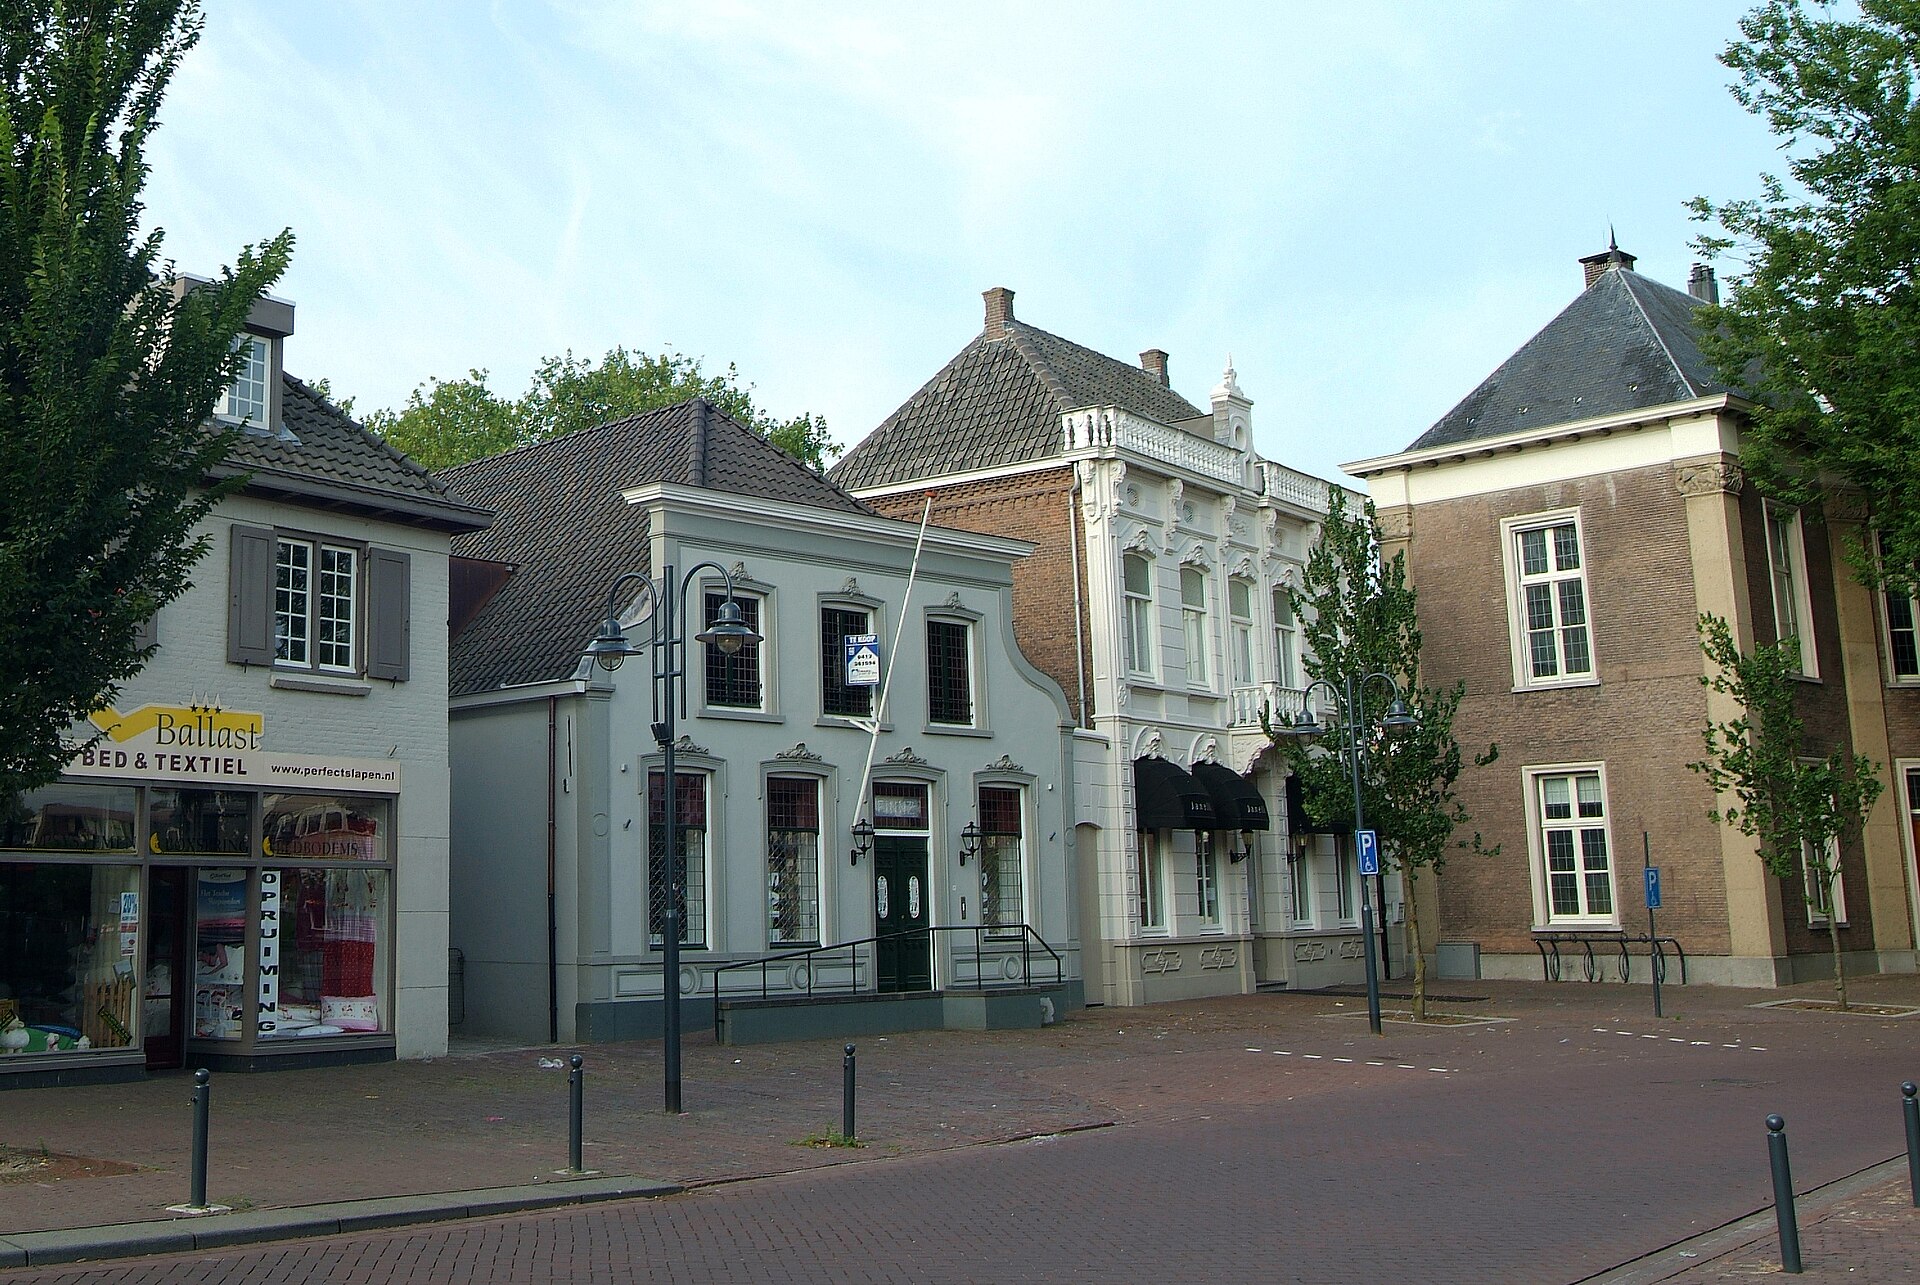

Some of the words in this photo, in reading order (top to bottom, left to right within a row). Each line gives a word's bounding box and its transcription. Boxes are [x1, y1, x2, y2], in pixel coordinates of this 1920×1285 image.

[155, 713, 260, 750] Ballast
[82, 750, 128, 769] BED
[134, 752, 148, 770] &
[154, 753, 248, 776] TEXTIEL
[270, 764, 395, 781] www.perfectslapen.nl
[1361, 833, 1372, 856] P
[1648, 871, 1657, 891] P
[258, 873, 278, 1032] OPRUIMING
